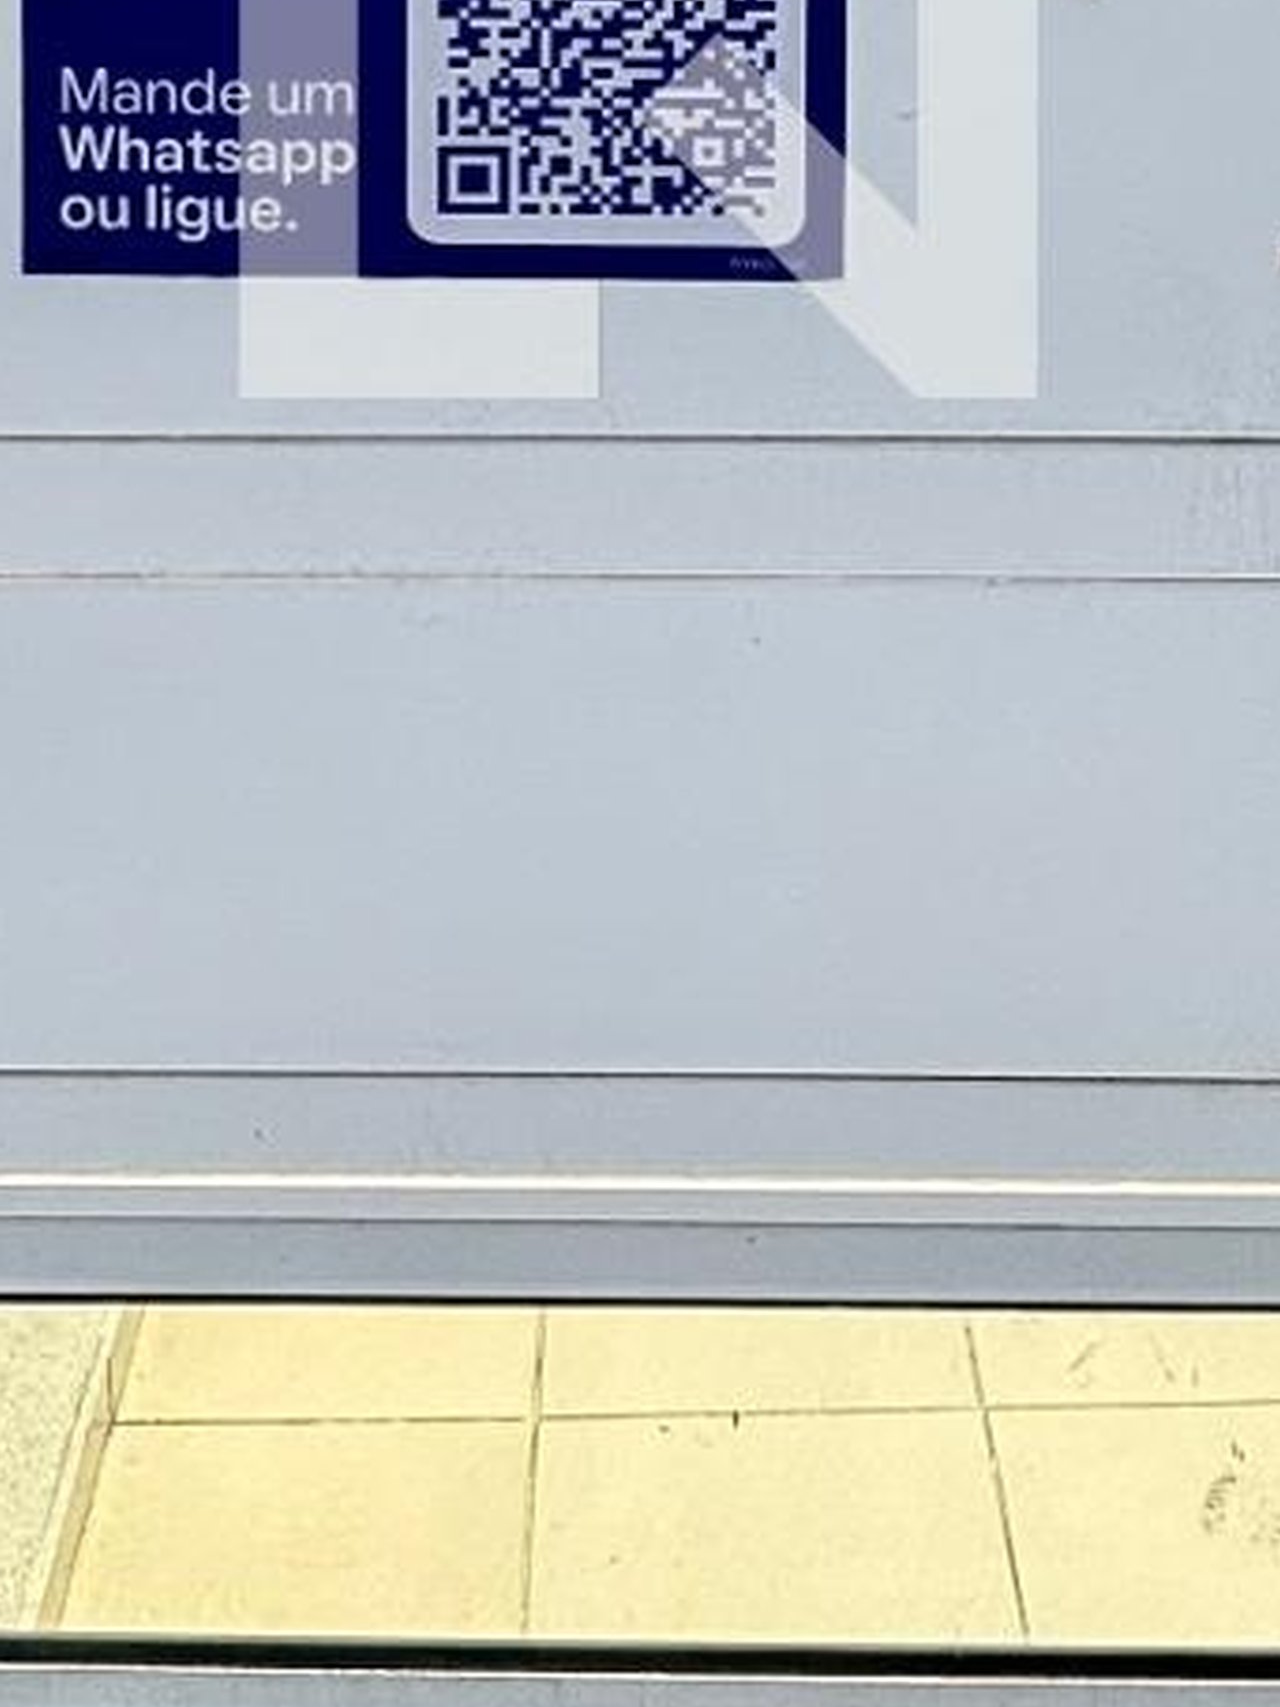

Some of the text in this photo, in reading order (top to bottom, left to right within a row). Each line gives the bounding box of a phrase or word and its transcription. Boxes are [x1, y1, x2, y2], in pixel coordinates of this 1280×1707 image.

[61, 66, 355, 116] Mande um
[59, 124, 357, 186] Whatsapp
[60, 183, 299, 242] ou ligue.
